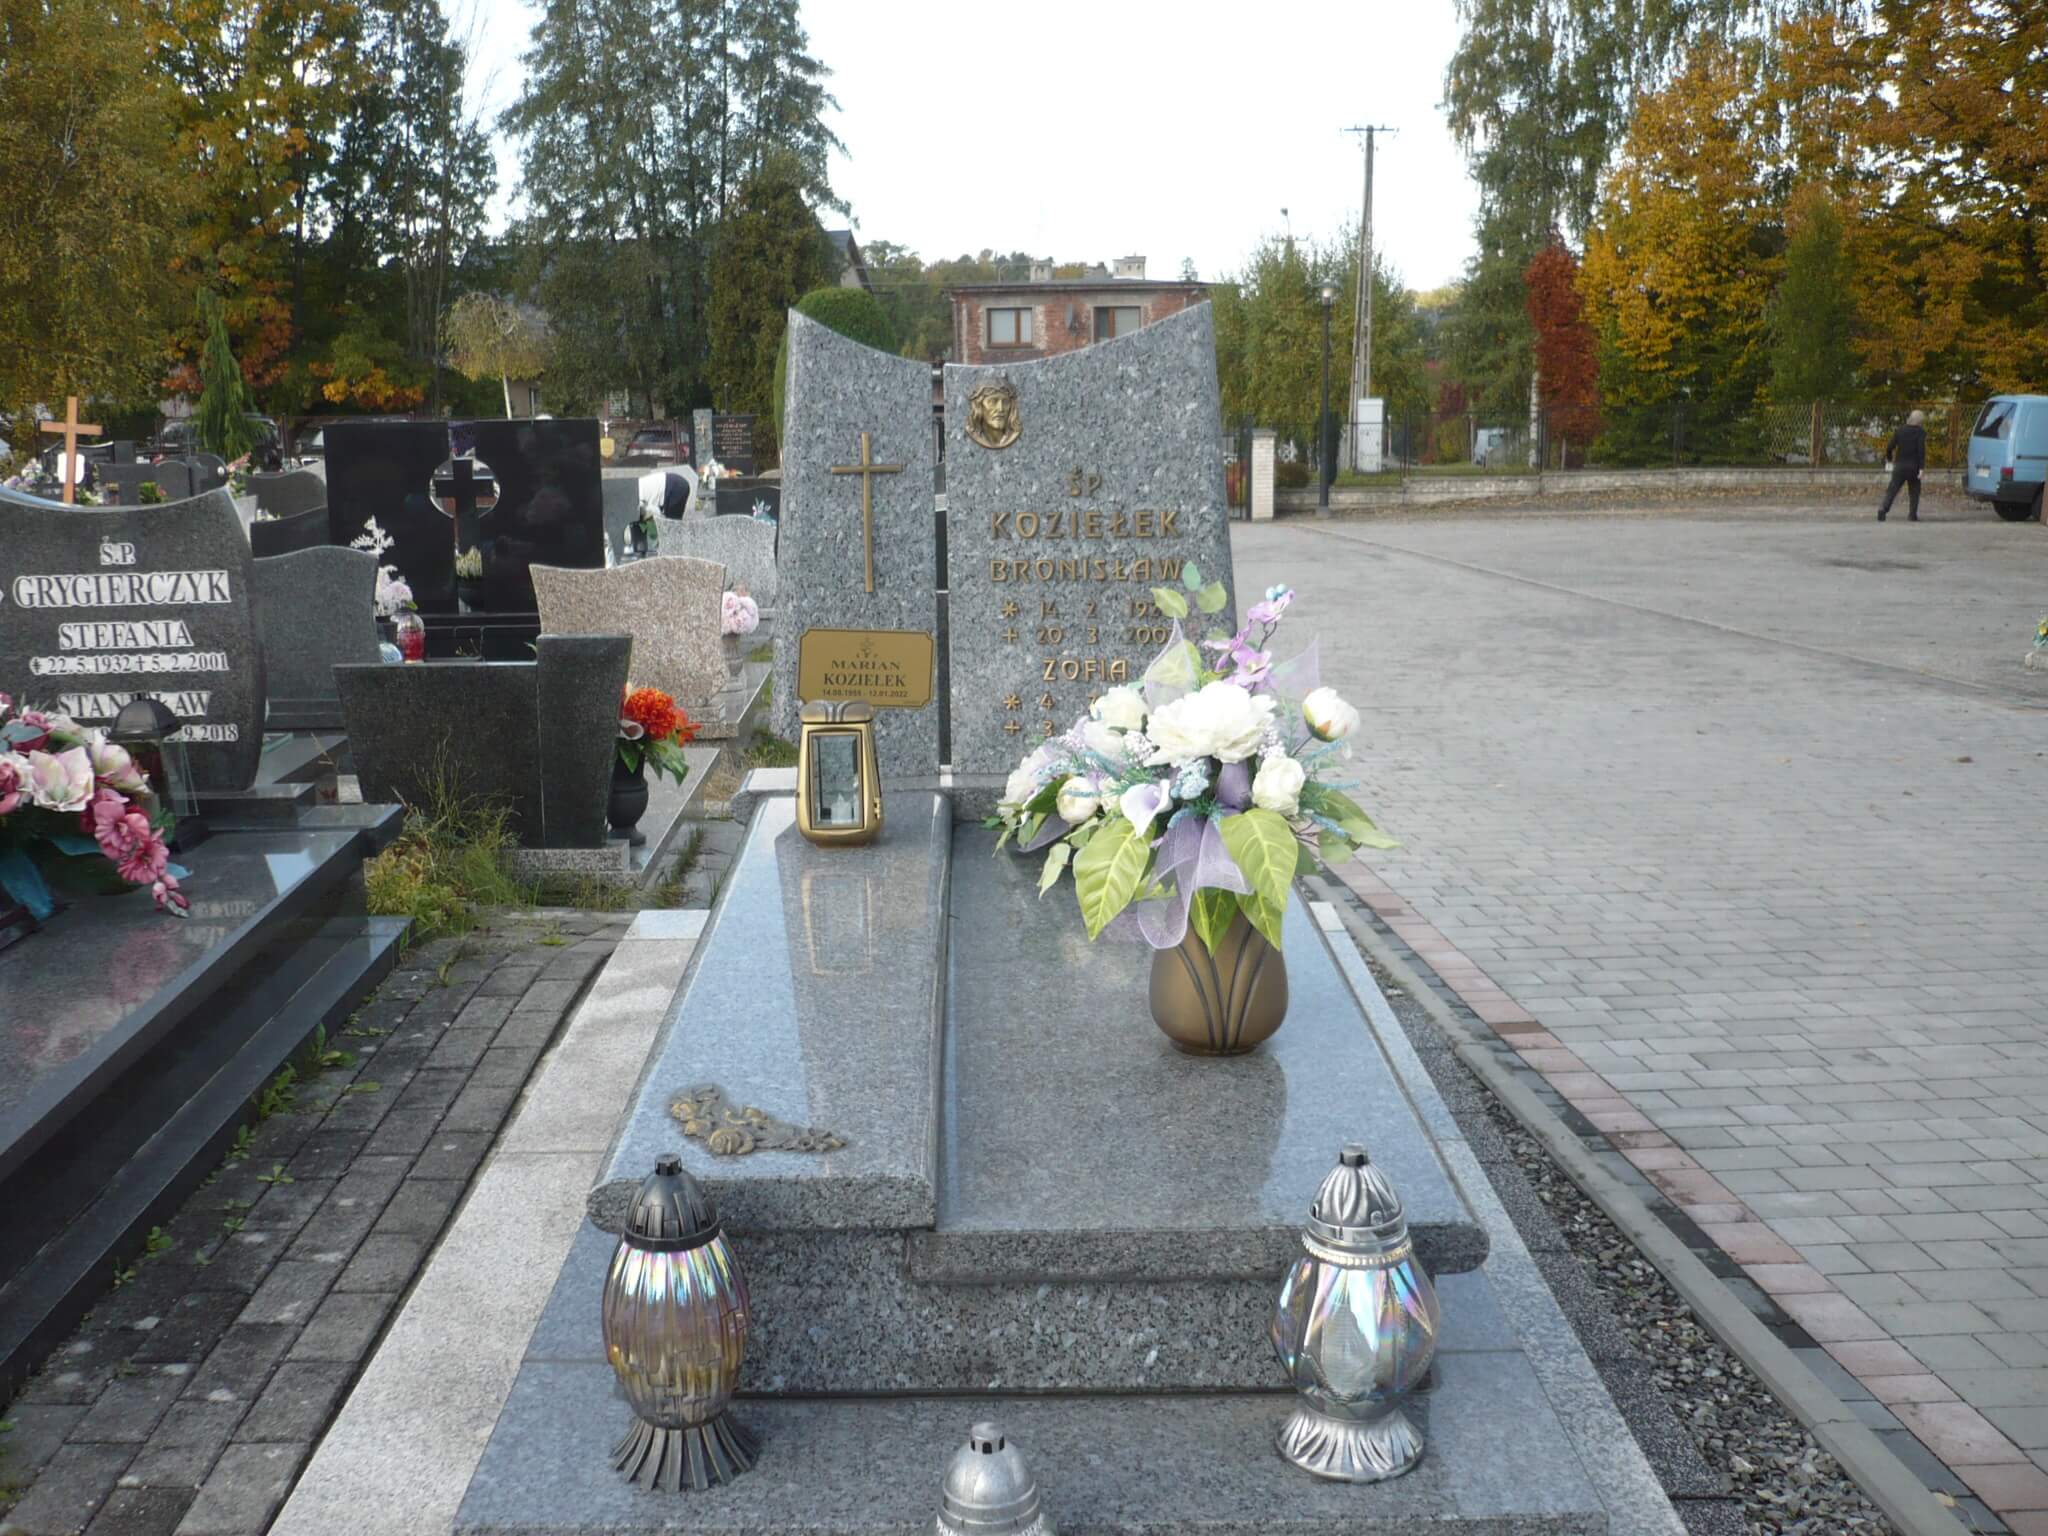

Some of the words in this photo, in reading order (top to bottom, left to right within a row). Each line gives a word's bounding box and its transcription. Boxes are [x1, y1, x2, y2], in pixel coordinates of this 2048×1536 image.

[990, 510, 1184, 540] KOZIEŁEK
[990, 558, 1184, 583] BRONISŁAW
[14, 572, 231, 607] GRYGIERCZYK
[1087, 601, 1096, 618] 2
[59, 621, 194, 649] STEFANIA
[1037, 627, 1064, 645] 20
[1087, 627, 1098, 644] 3
[831, 660, 900, 670] MARIAN
[1043, 659, 1129, 682] ZOFIA
[1040, 693, 1055, 710] 4
[1043, 720, 1055, 737] 3
